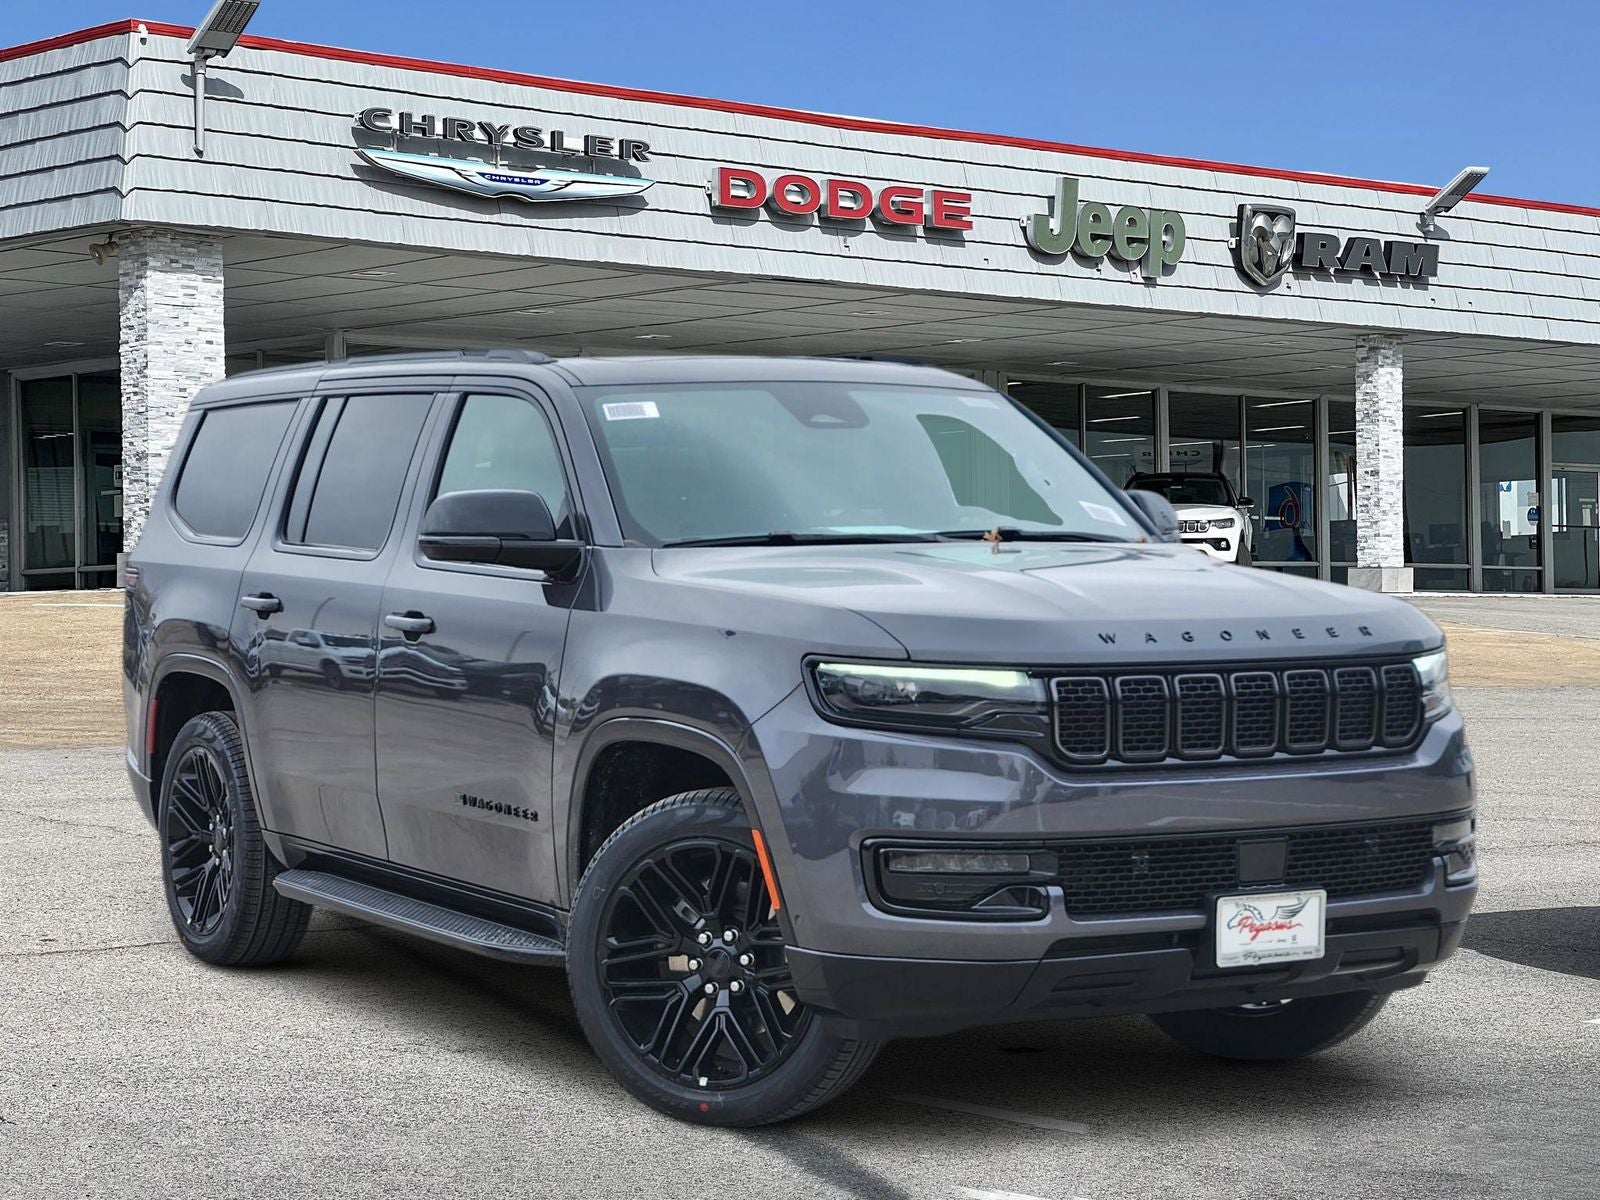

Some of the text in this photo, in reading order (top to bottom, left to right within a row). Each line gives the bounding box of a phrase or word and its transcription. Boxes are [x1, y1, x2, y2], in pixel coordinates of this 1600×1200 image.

[358, 107, 651, 162] CHRYSLER
[484, 174, 541, 185] CHRYSLER
[711, 166, 973, 230] DODGE
[1028, 177, 1186, 278] Jeep
[1297, 232, 1440, 277] RAM
[1097, 625, 1373, 645] WAGONEER
[1237, 916, 1304, 942] Pegasus
